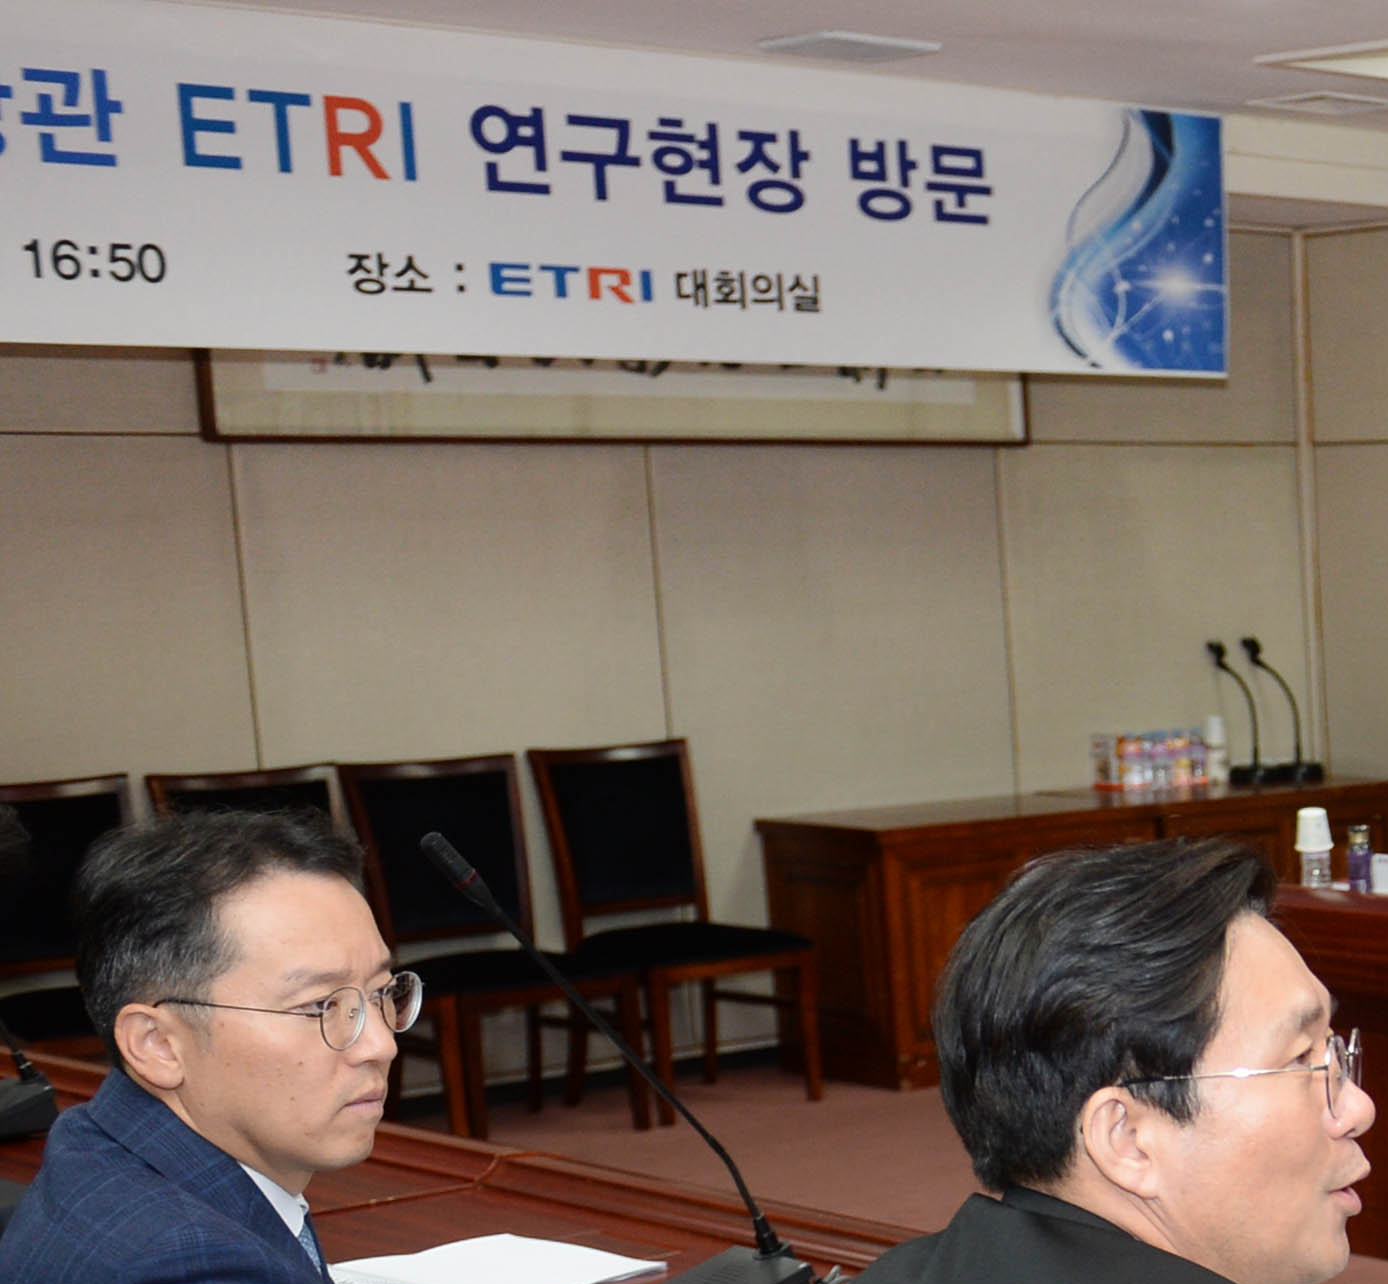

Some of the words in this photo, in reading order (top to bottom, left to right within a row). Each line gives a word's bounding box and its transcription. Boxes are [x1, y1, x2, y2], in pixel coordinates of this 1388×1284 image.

[177, 83, 417, 182] ETRI
[469, 104, 810, 214] 연구현장
[847, 138, 994, 226] 방문
[22, 238, 167, 283] 16:50
[488, 262, 655, 303] ETRI
[674, 269, 822, 312] 대회의실
